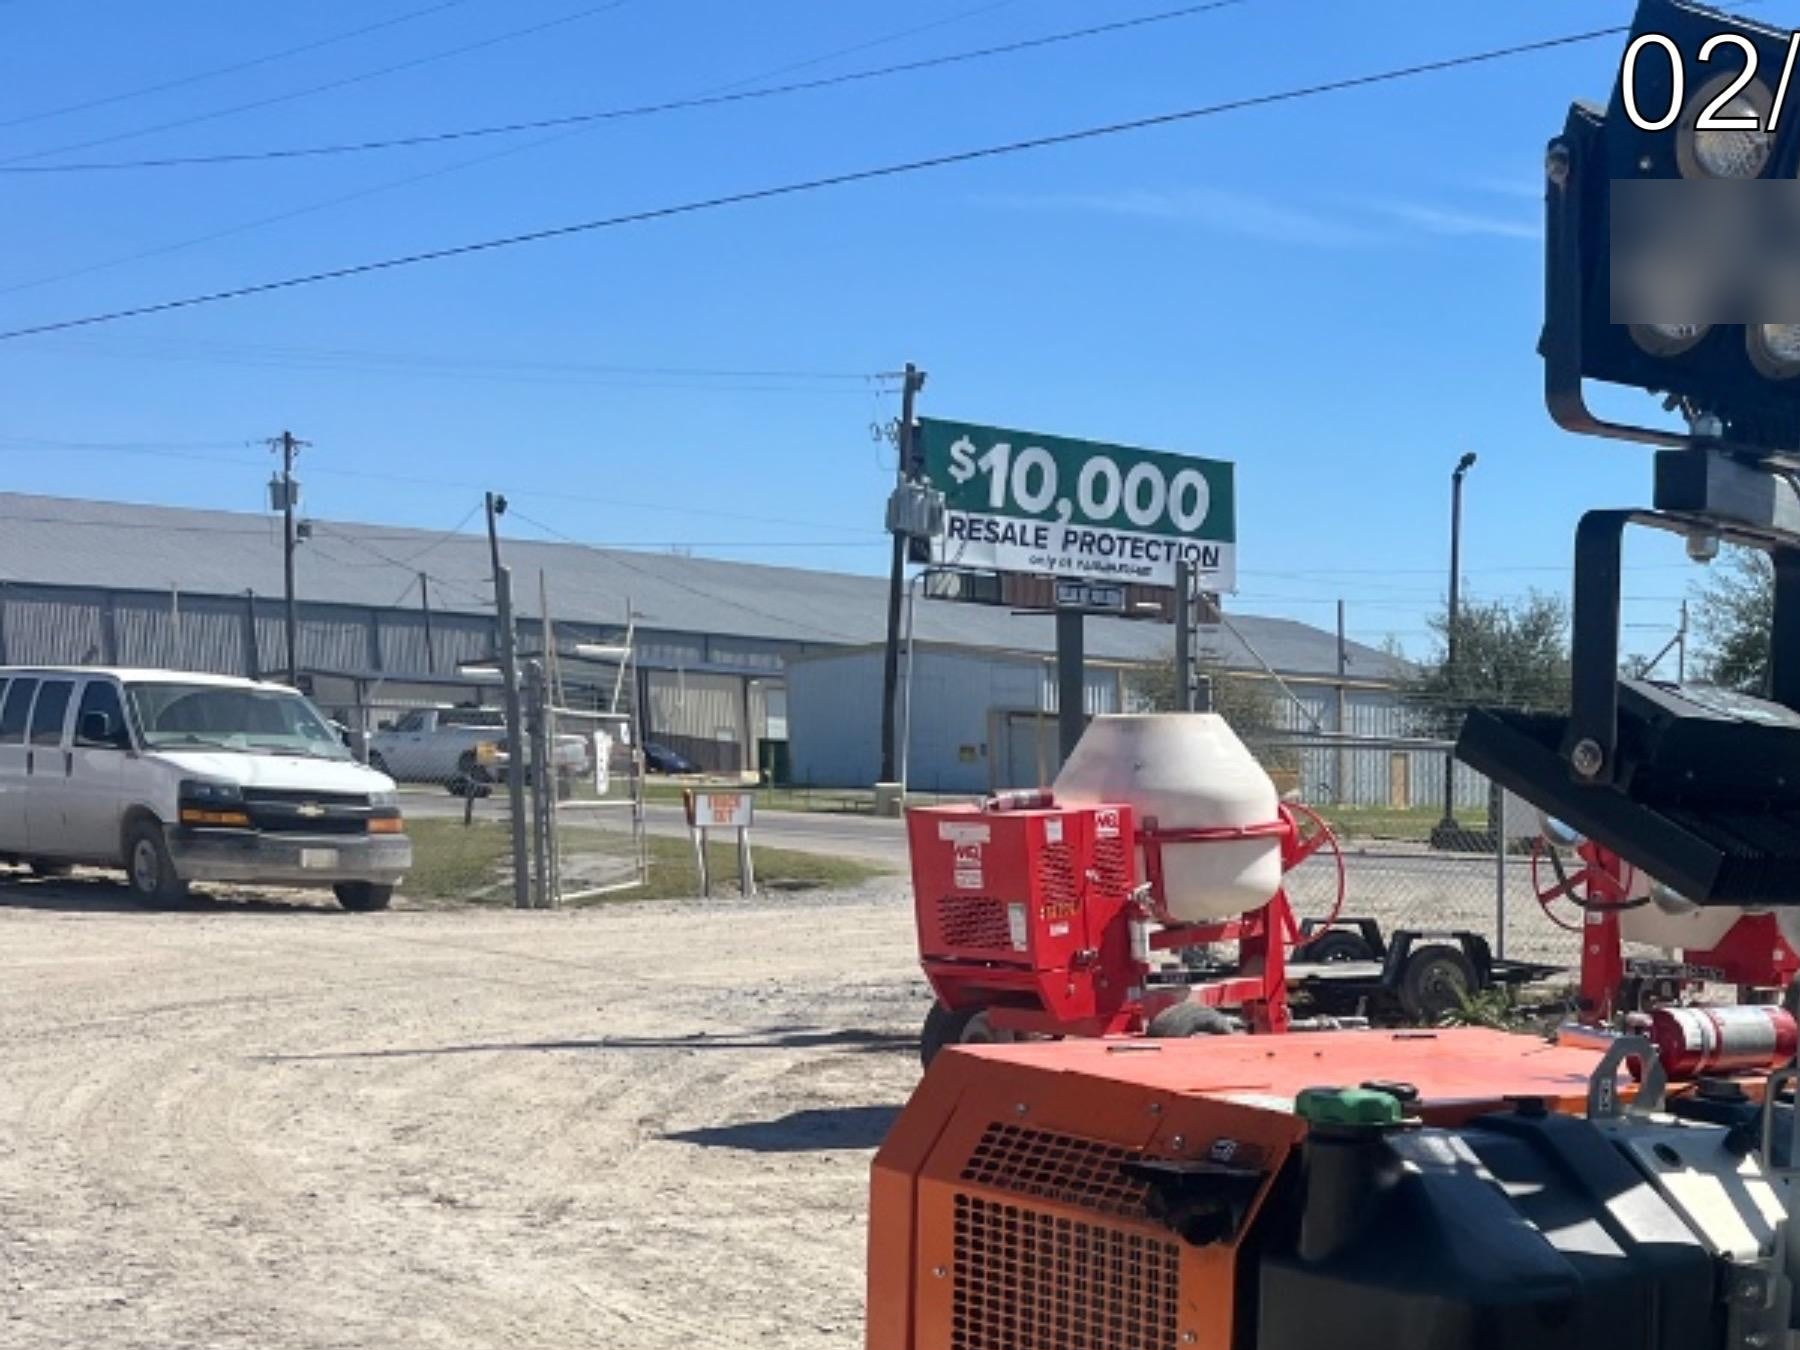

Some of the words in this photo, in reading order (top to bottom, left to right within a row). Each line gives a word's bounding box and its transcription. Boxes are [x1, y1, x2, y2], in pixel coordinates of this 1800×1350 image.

[948, 434, 1210, 532] $10,000
[949, 516, 1049, 549] RESALE
[1061, 529, 1219, 567] PROTECTION
